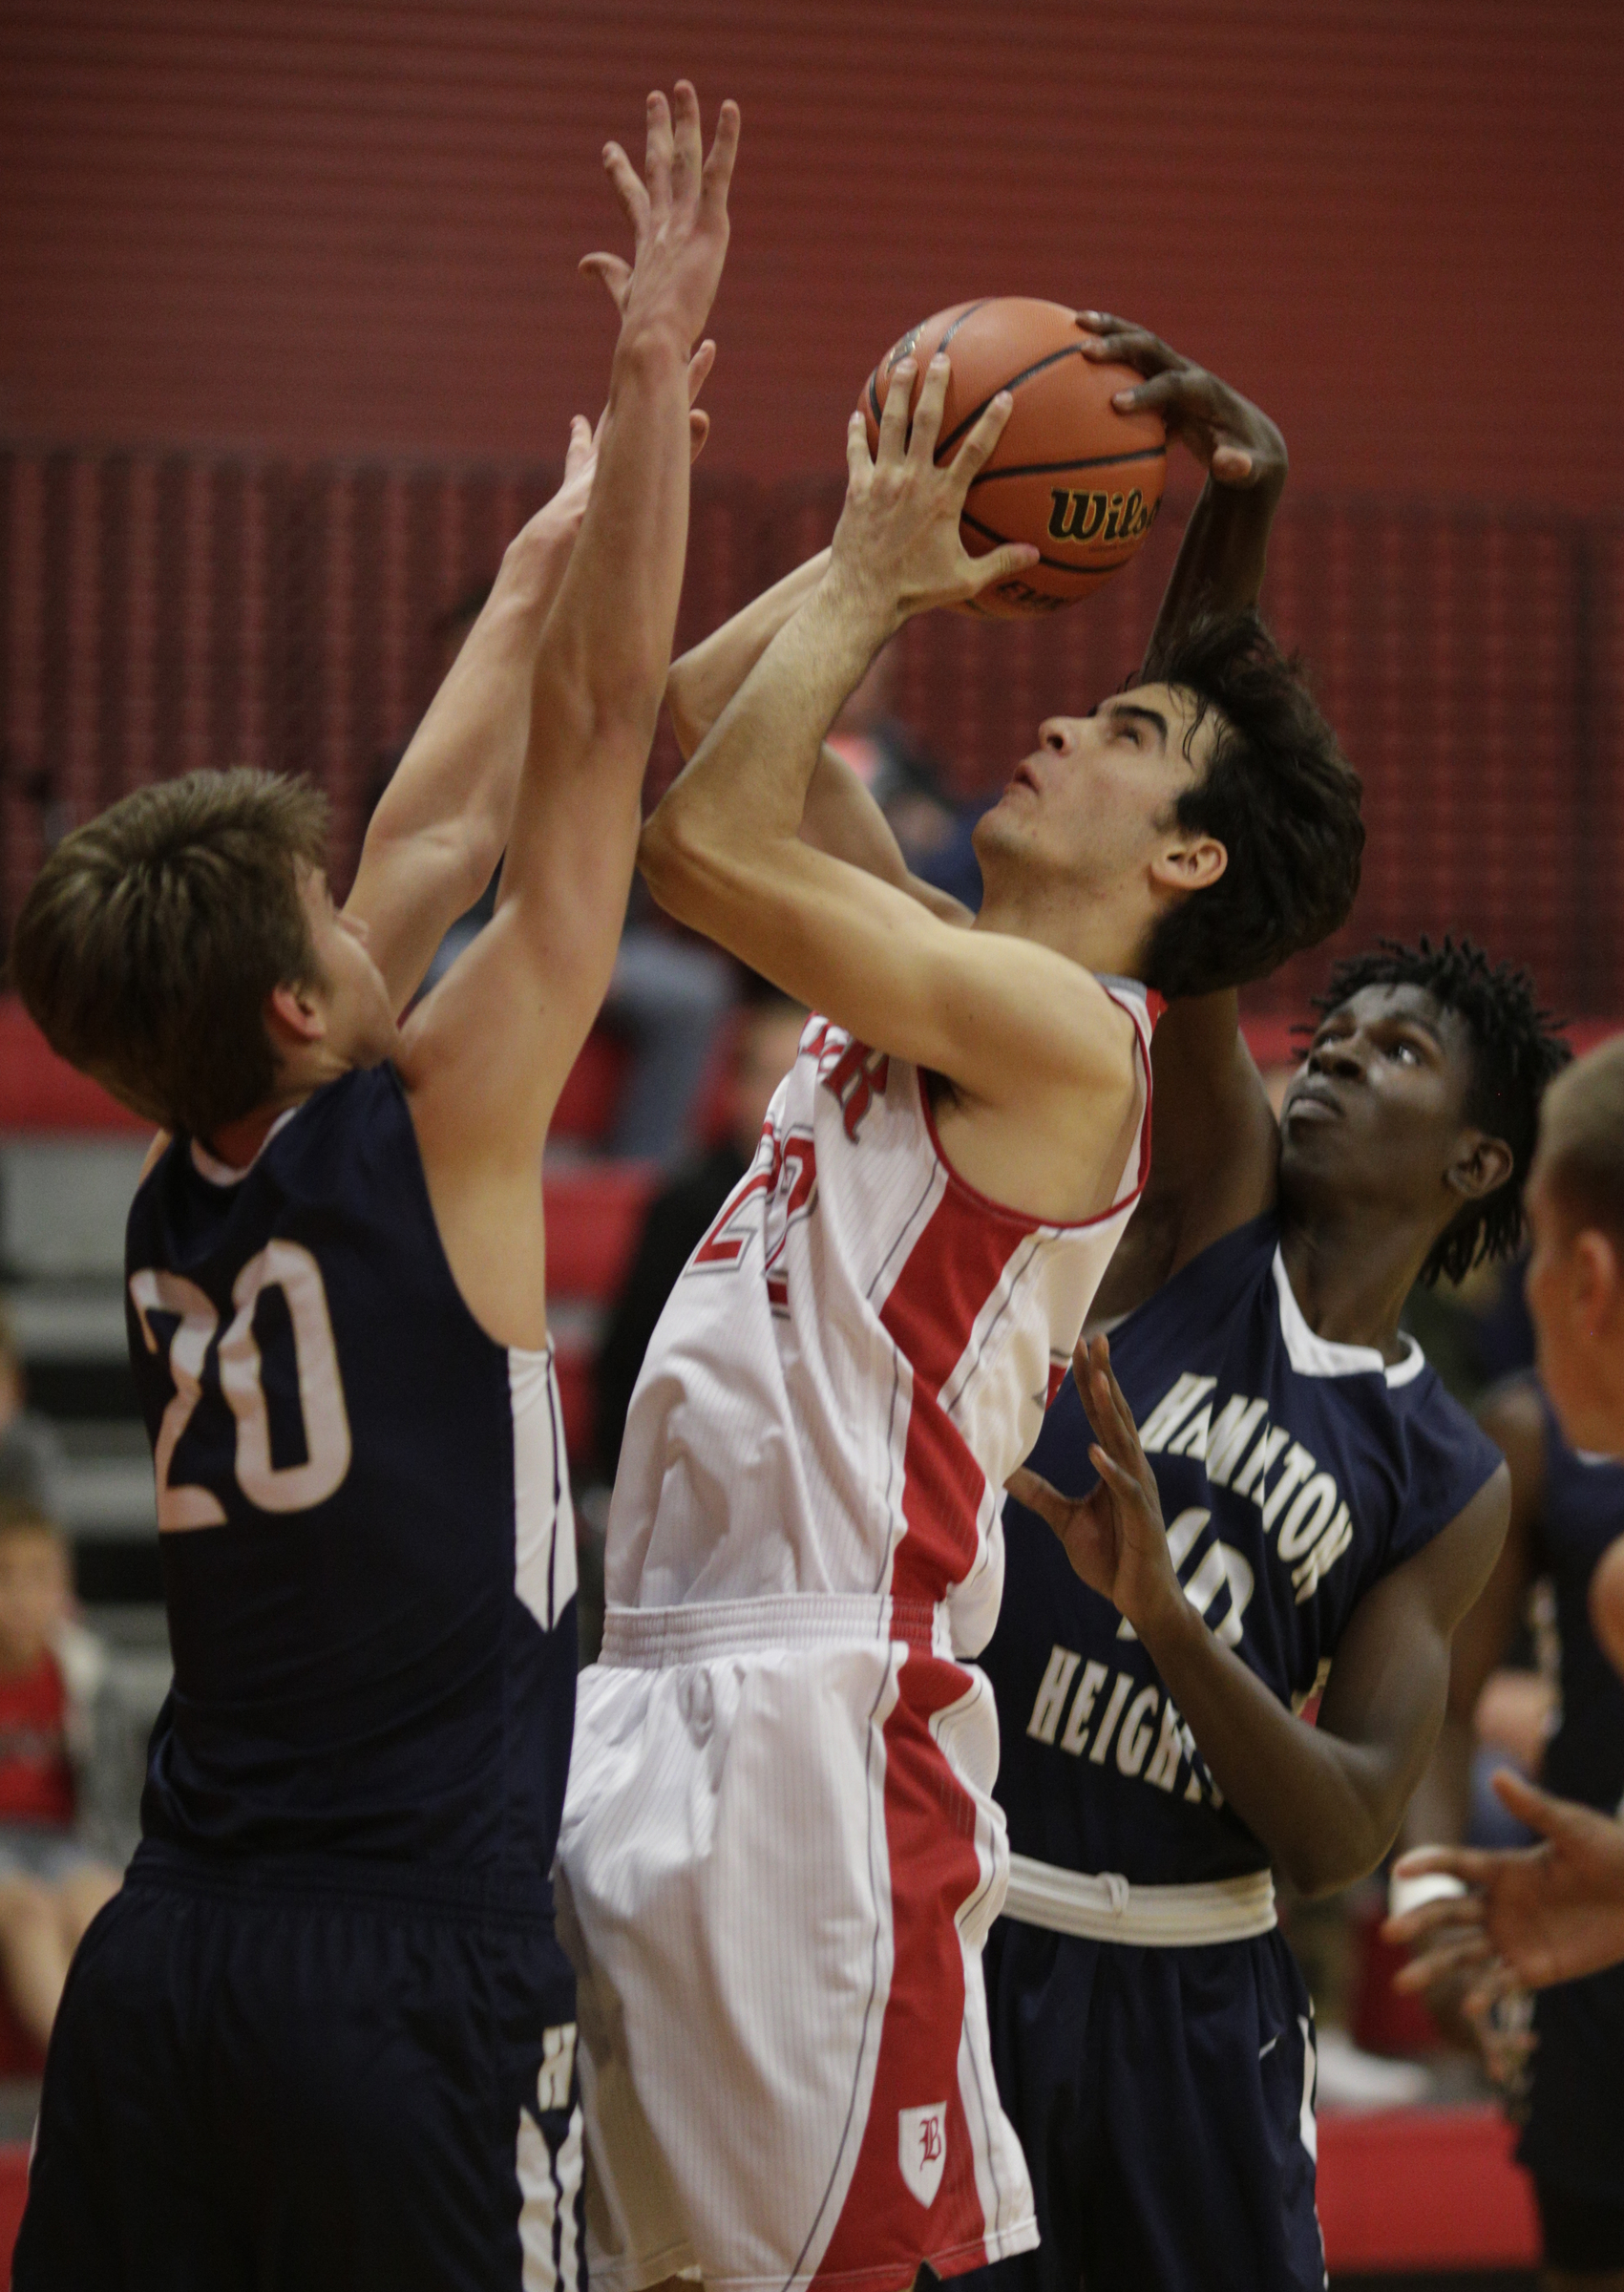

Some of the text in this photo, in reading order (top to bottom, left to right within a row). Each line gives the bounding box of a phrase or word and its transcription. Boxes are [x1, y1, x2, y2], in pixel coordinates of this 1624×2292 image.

[1047, 486, 1163, 545] Wils
[129, 1238, 352, 1533] 20
[1025, 1644, 1224, 1811] HEIGH
[918, 2115, 942, 2173] B
